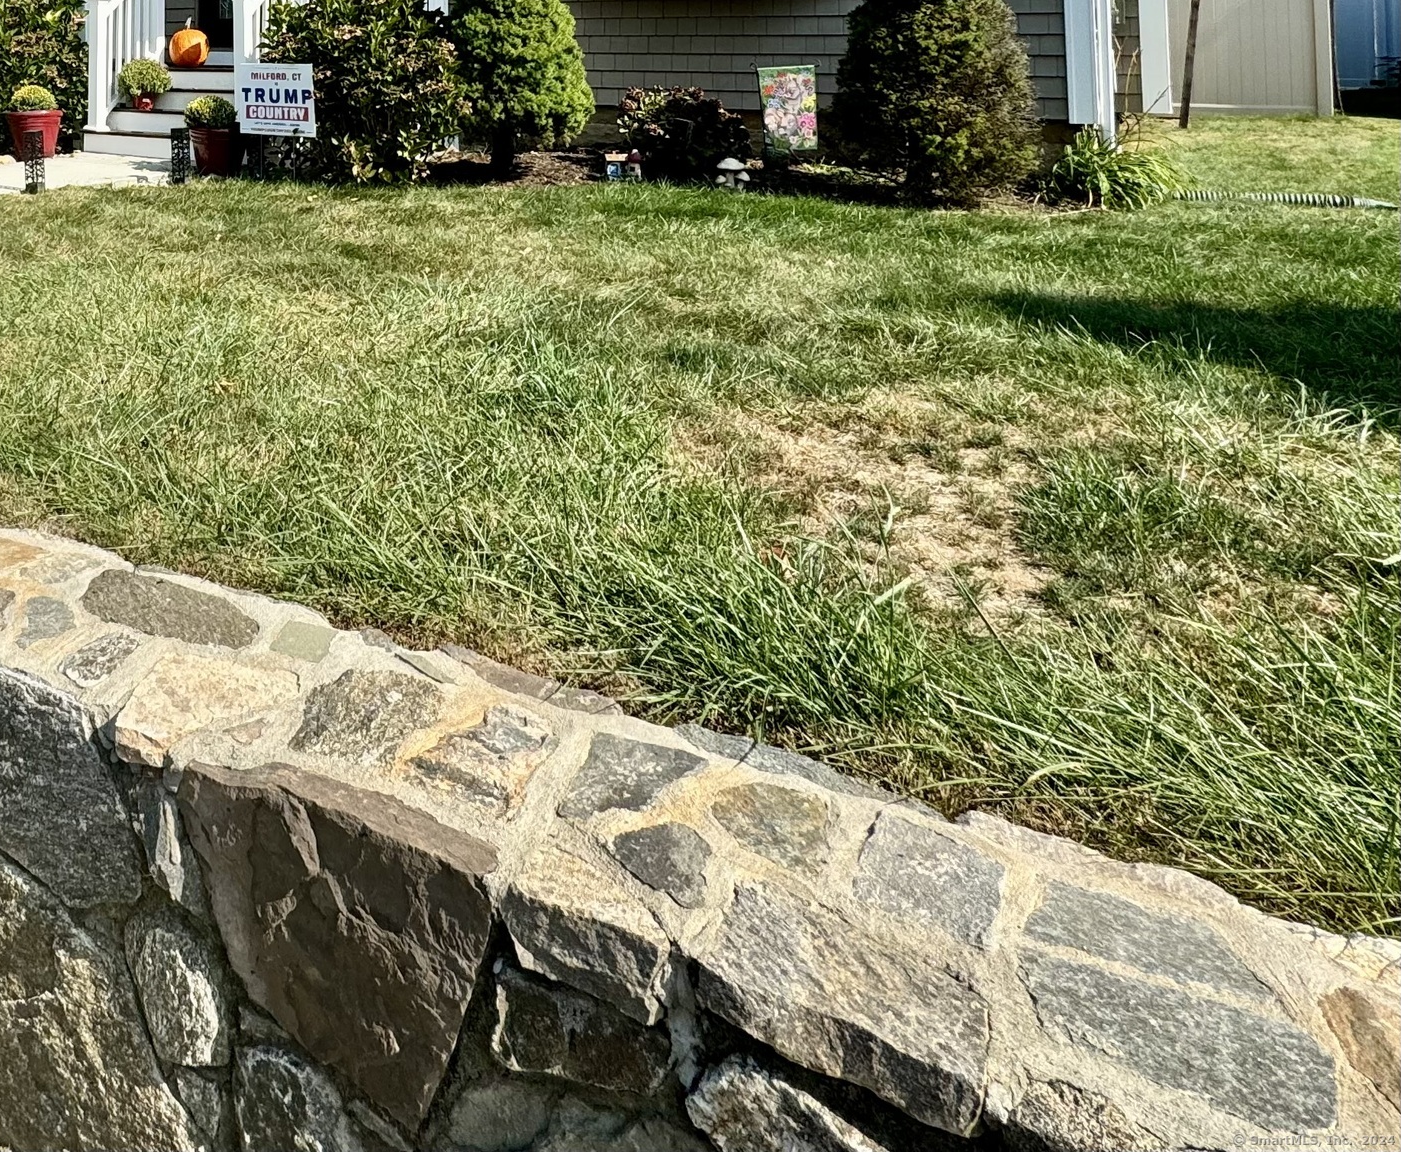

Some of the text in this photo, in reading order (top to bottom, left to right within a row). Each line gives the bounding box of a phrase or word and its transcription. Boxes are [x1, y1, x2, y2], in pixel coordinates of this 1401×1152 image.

[250, 72, 301, 81] MILFORD, CT
[241, 87, 312, 104] TRUMP
[249, 105, 305, 120] COUNTRY
